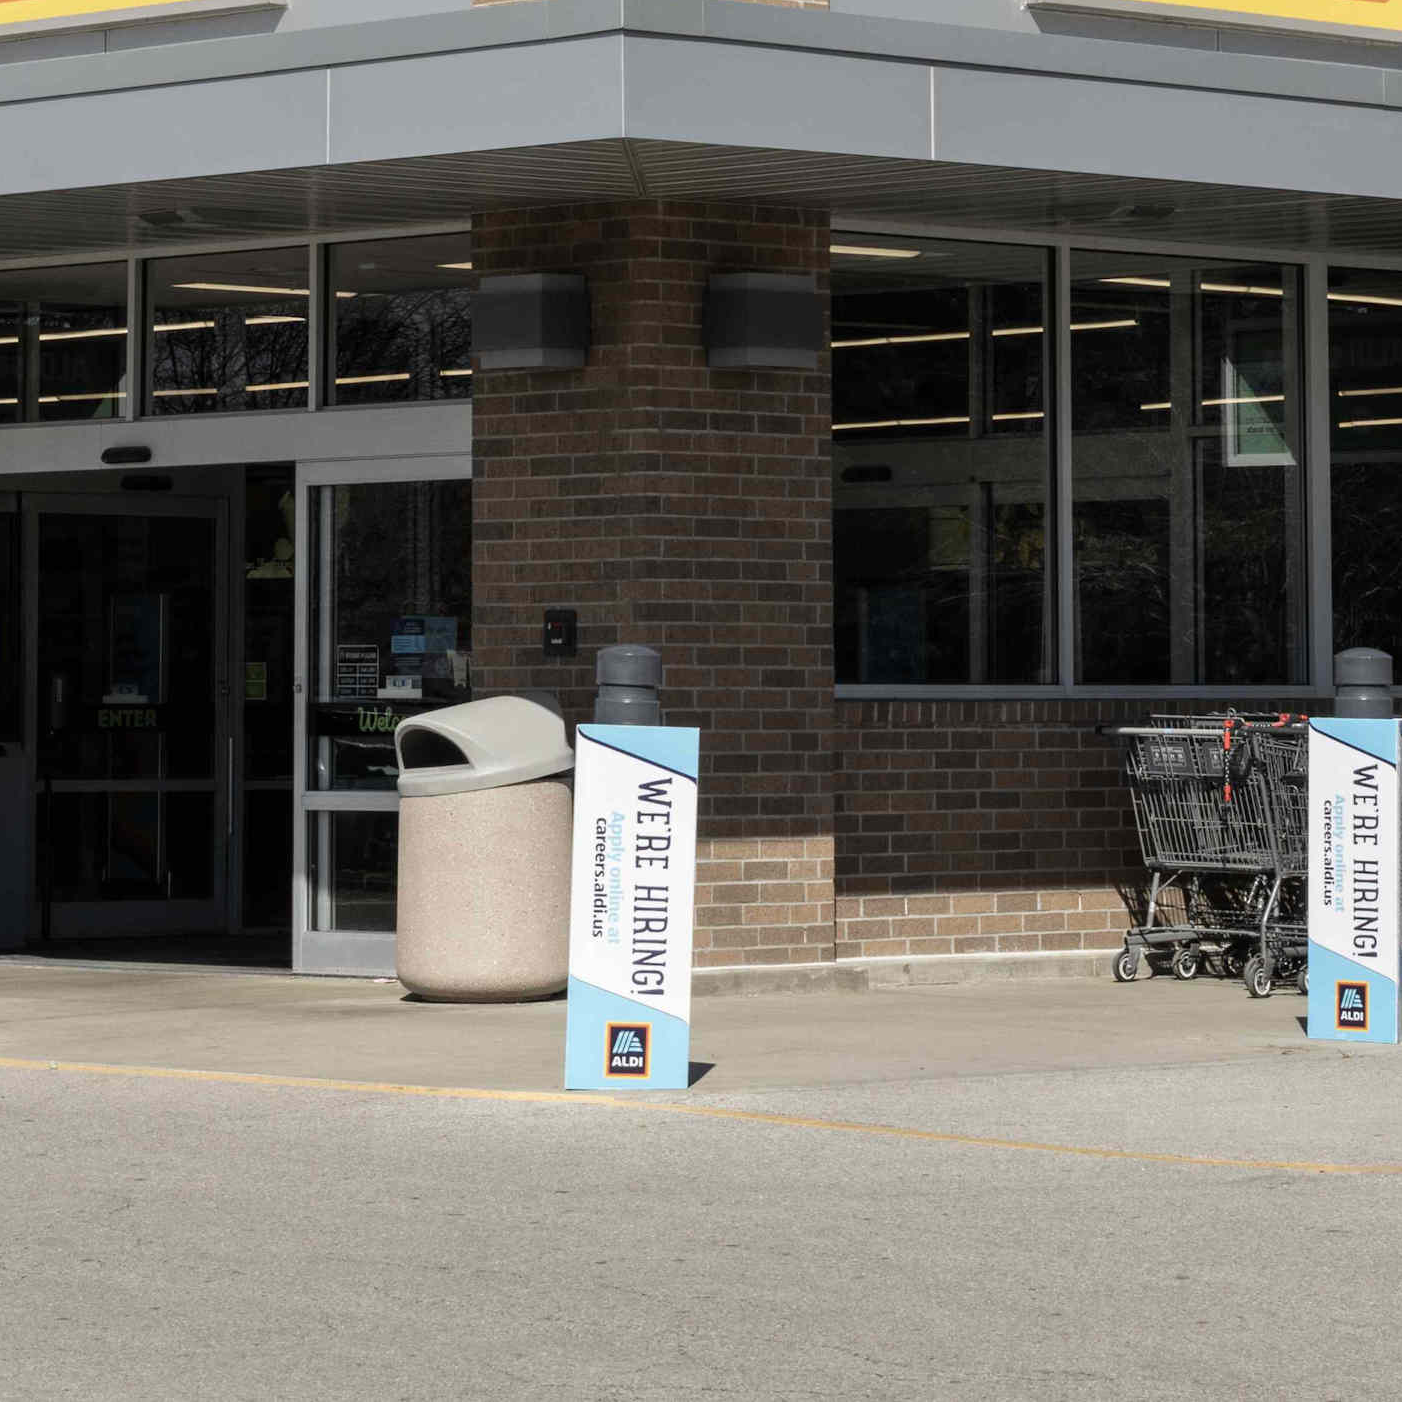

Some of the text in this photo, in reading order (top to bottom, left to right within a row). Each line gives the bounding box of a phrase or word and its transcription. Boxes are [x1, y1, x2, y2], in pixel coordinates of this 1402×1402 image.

[99, 709, 157, 727] ENTER
[358, 707, 406, 733] Welc
[607, 811, 626, 863] Apply
[1324, 800, 1334, 906] careers.aldi.us
[1352, 764, 1379, 958] WE'RE HIRING!
[592, 817, 608, 938] careers.aldi.us
[608, 866, 624, 923] online
[630, 777, 673, 996] WE'RE HIRING!
[1340, 1010, 1364, 1021] ALDI
[611, 1055, 644, 1068] ALDI
